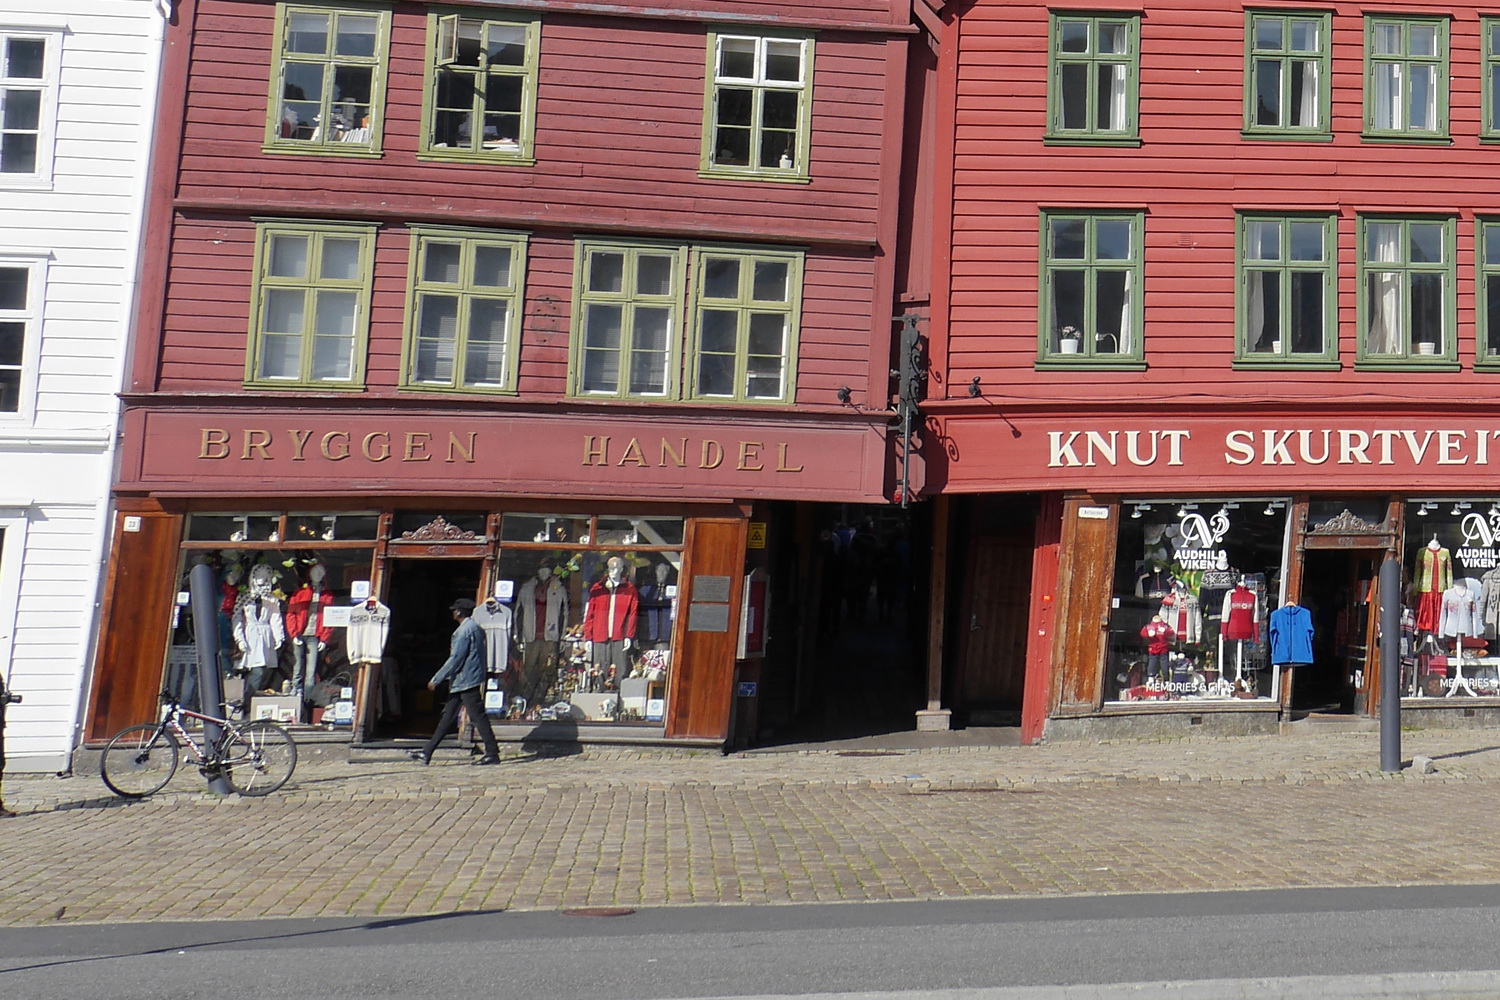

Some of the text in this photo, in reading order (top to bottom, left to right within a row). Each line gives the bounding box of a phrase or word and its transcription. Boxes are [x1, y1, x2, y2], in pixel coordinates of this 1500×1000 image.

[198, 427, 804, 473] BRYGGEN HANDEL
[1046, 429, 1191, 467] KNUT
[1173, 549, 1227, 560] AUDHILD
[1179, 559, 1216, 570] VIKEN
[1461, 558, 1497, 568] VIKEN
[1145, 682, 1197, 692] MEMORIES
[1439, 678, 1489, 688] MERIES
